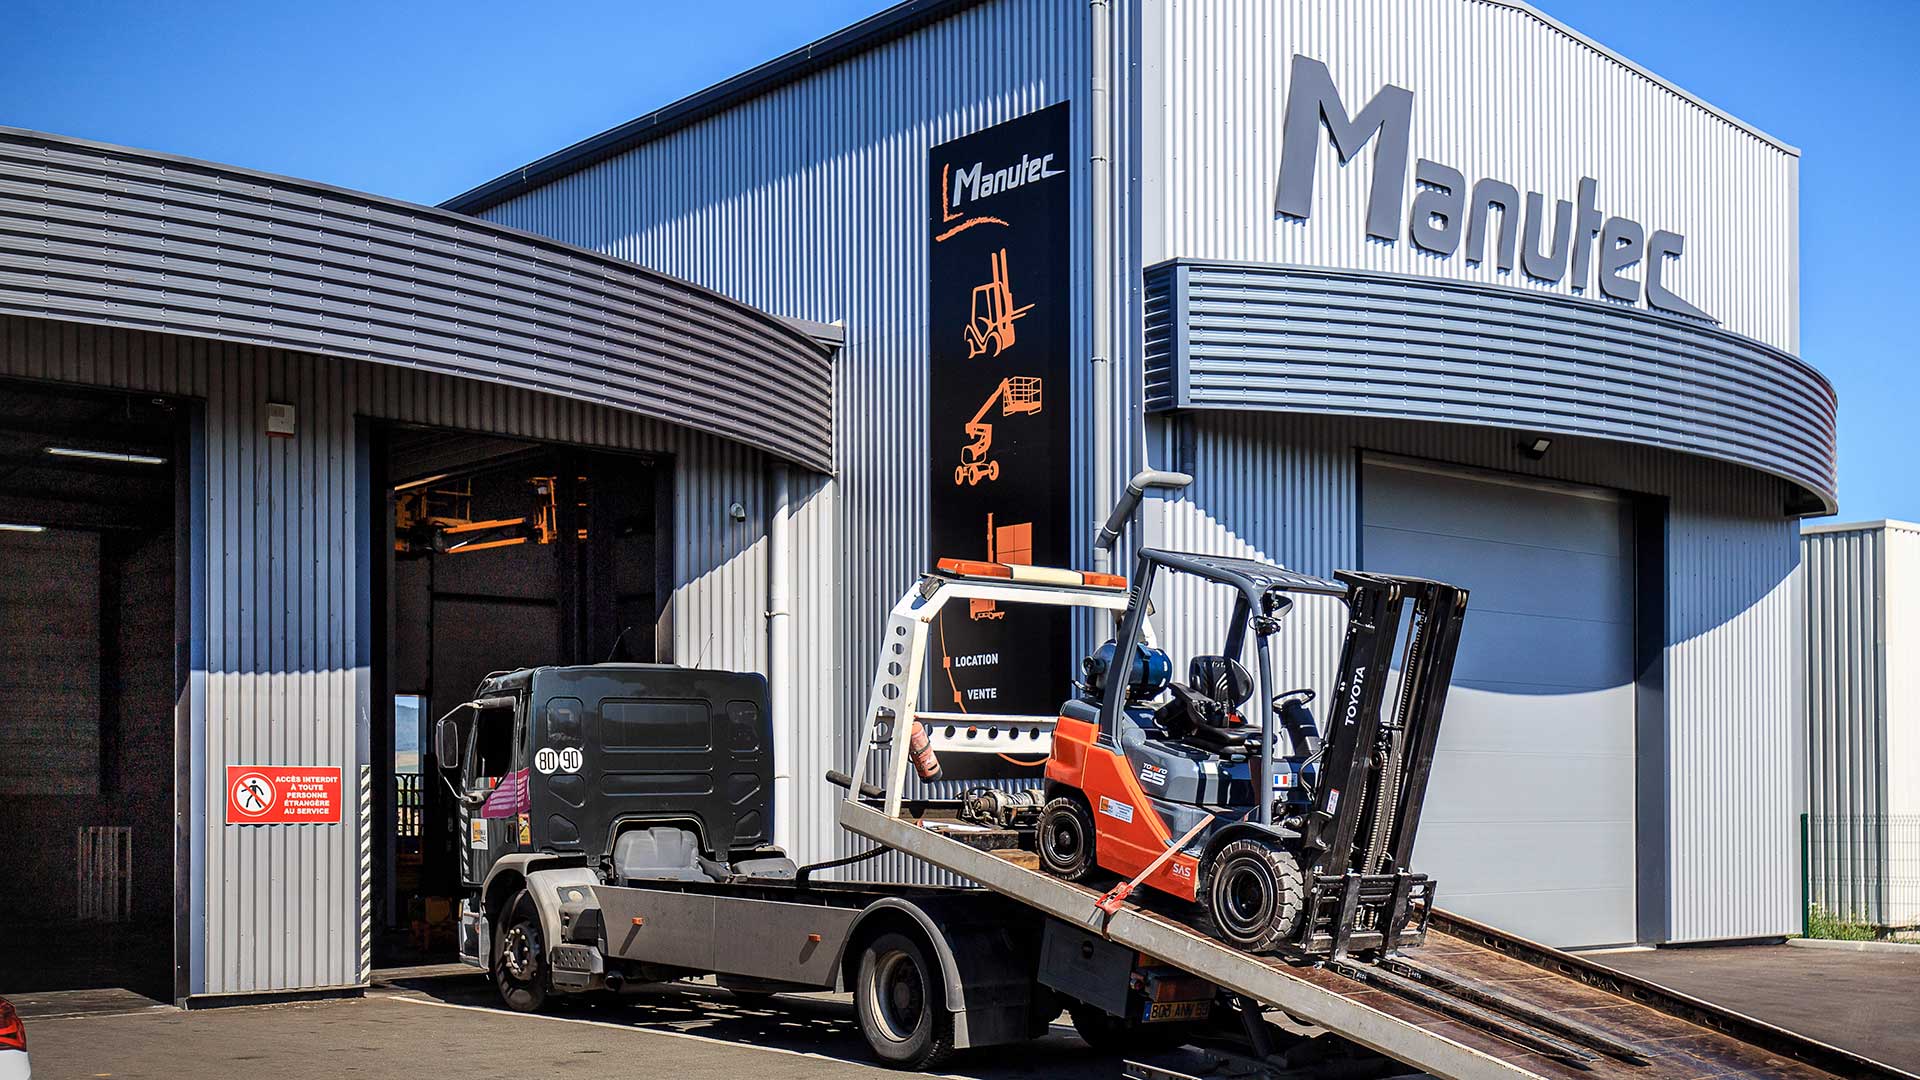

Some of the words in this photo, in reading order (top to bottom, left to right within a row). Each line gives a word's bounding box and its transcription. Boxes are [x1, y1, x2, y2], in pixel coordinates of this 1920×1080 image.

[952, 153, 1066, 207] Manutec
[1275, 53, 1721, 324] Manutec
[955, 653, 999, 667] LOCATION
[967, 688, 997, 700] VENTE
[1344, 666, 1366, 726] TOYOTA
[539, 751, 555, 770] 80
[563, 751, 579, 770] 90
[275, 775, 301, 783] ACCÈS
[1140, 769, 1166, 786] 25
[1173, 863, 1191, 877] SAS
